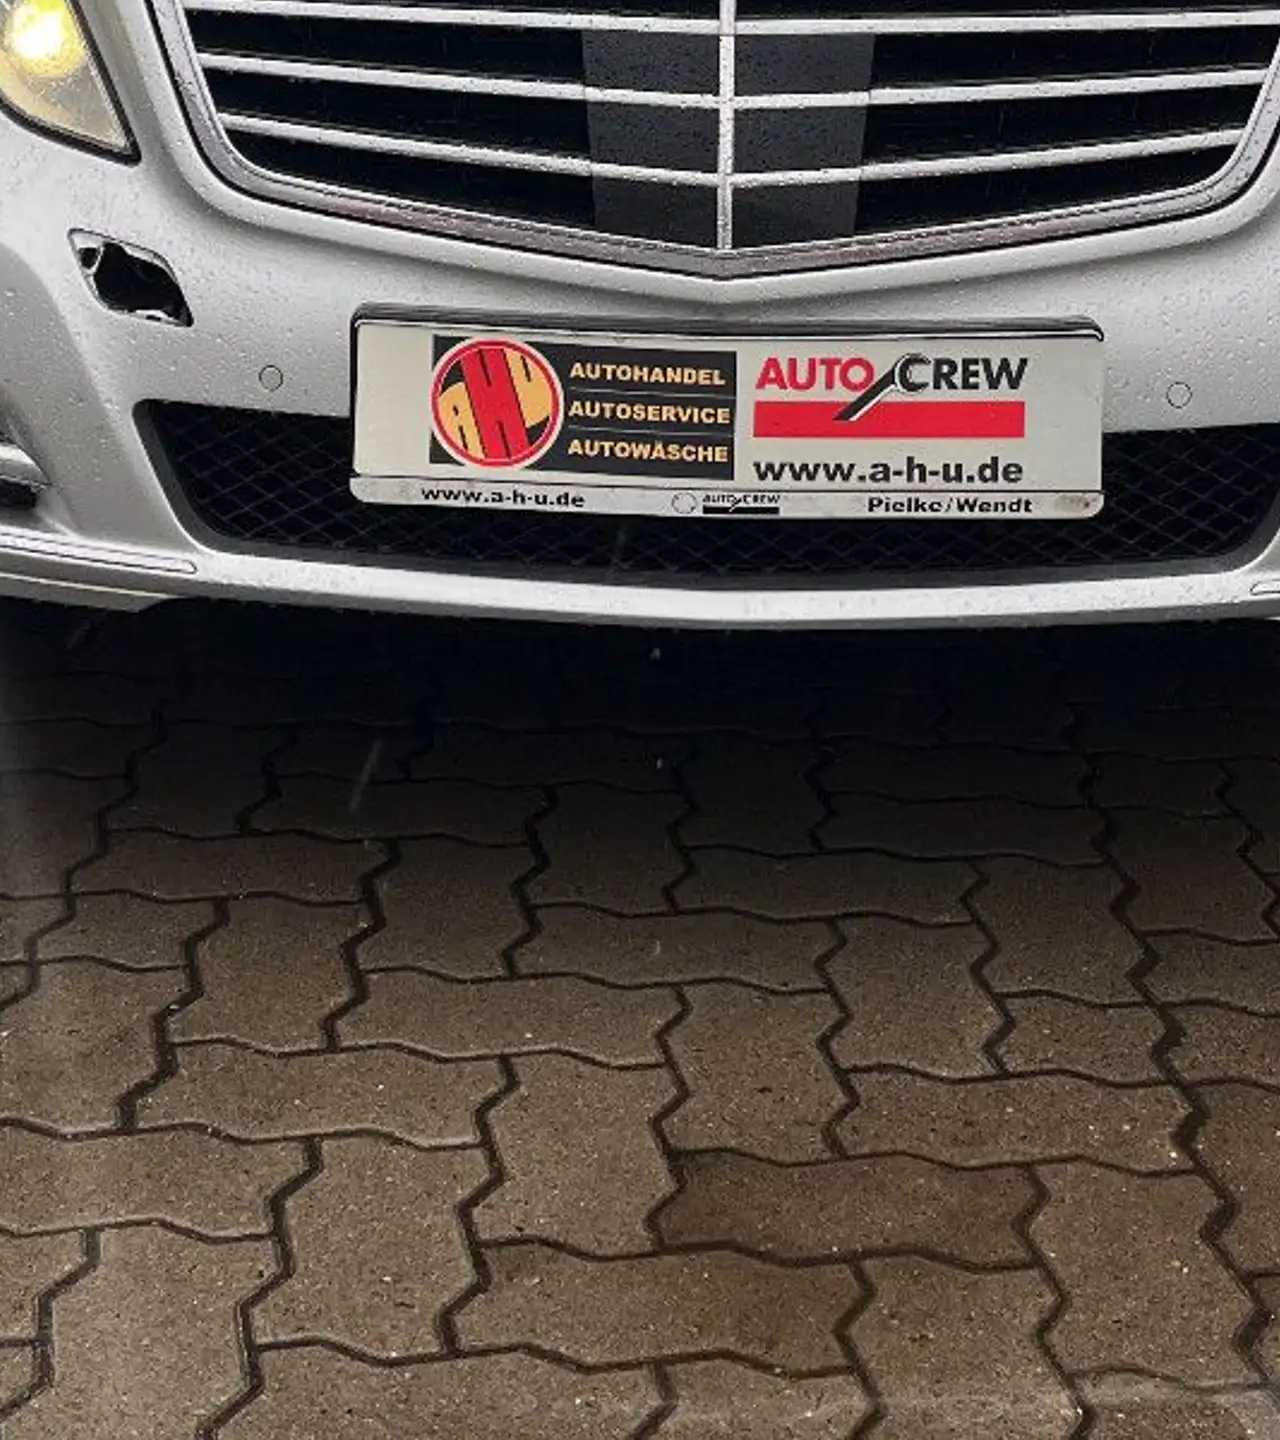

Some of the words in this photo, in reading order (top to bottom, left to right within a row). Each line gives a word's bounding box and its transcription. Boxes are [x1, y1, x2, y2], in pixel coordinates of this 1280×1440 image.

[570, 362, 726, 386] AUTOHANDEL
[754, 357, 875, 391] AUTO
[899, 353, 1029, 393] CREW
[569, 400, 731, 425] AUTOSERVICE
[568, 438, 729, 463] AUTOWÄSCHE
[753, 456, 1024, 484] www.a-h-u.de
[421, 487, 587, 509] www.a-h-u.de
